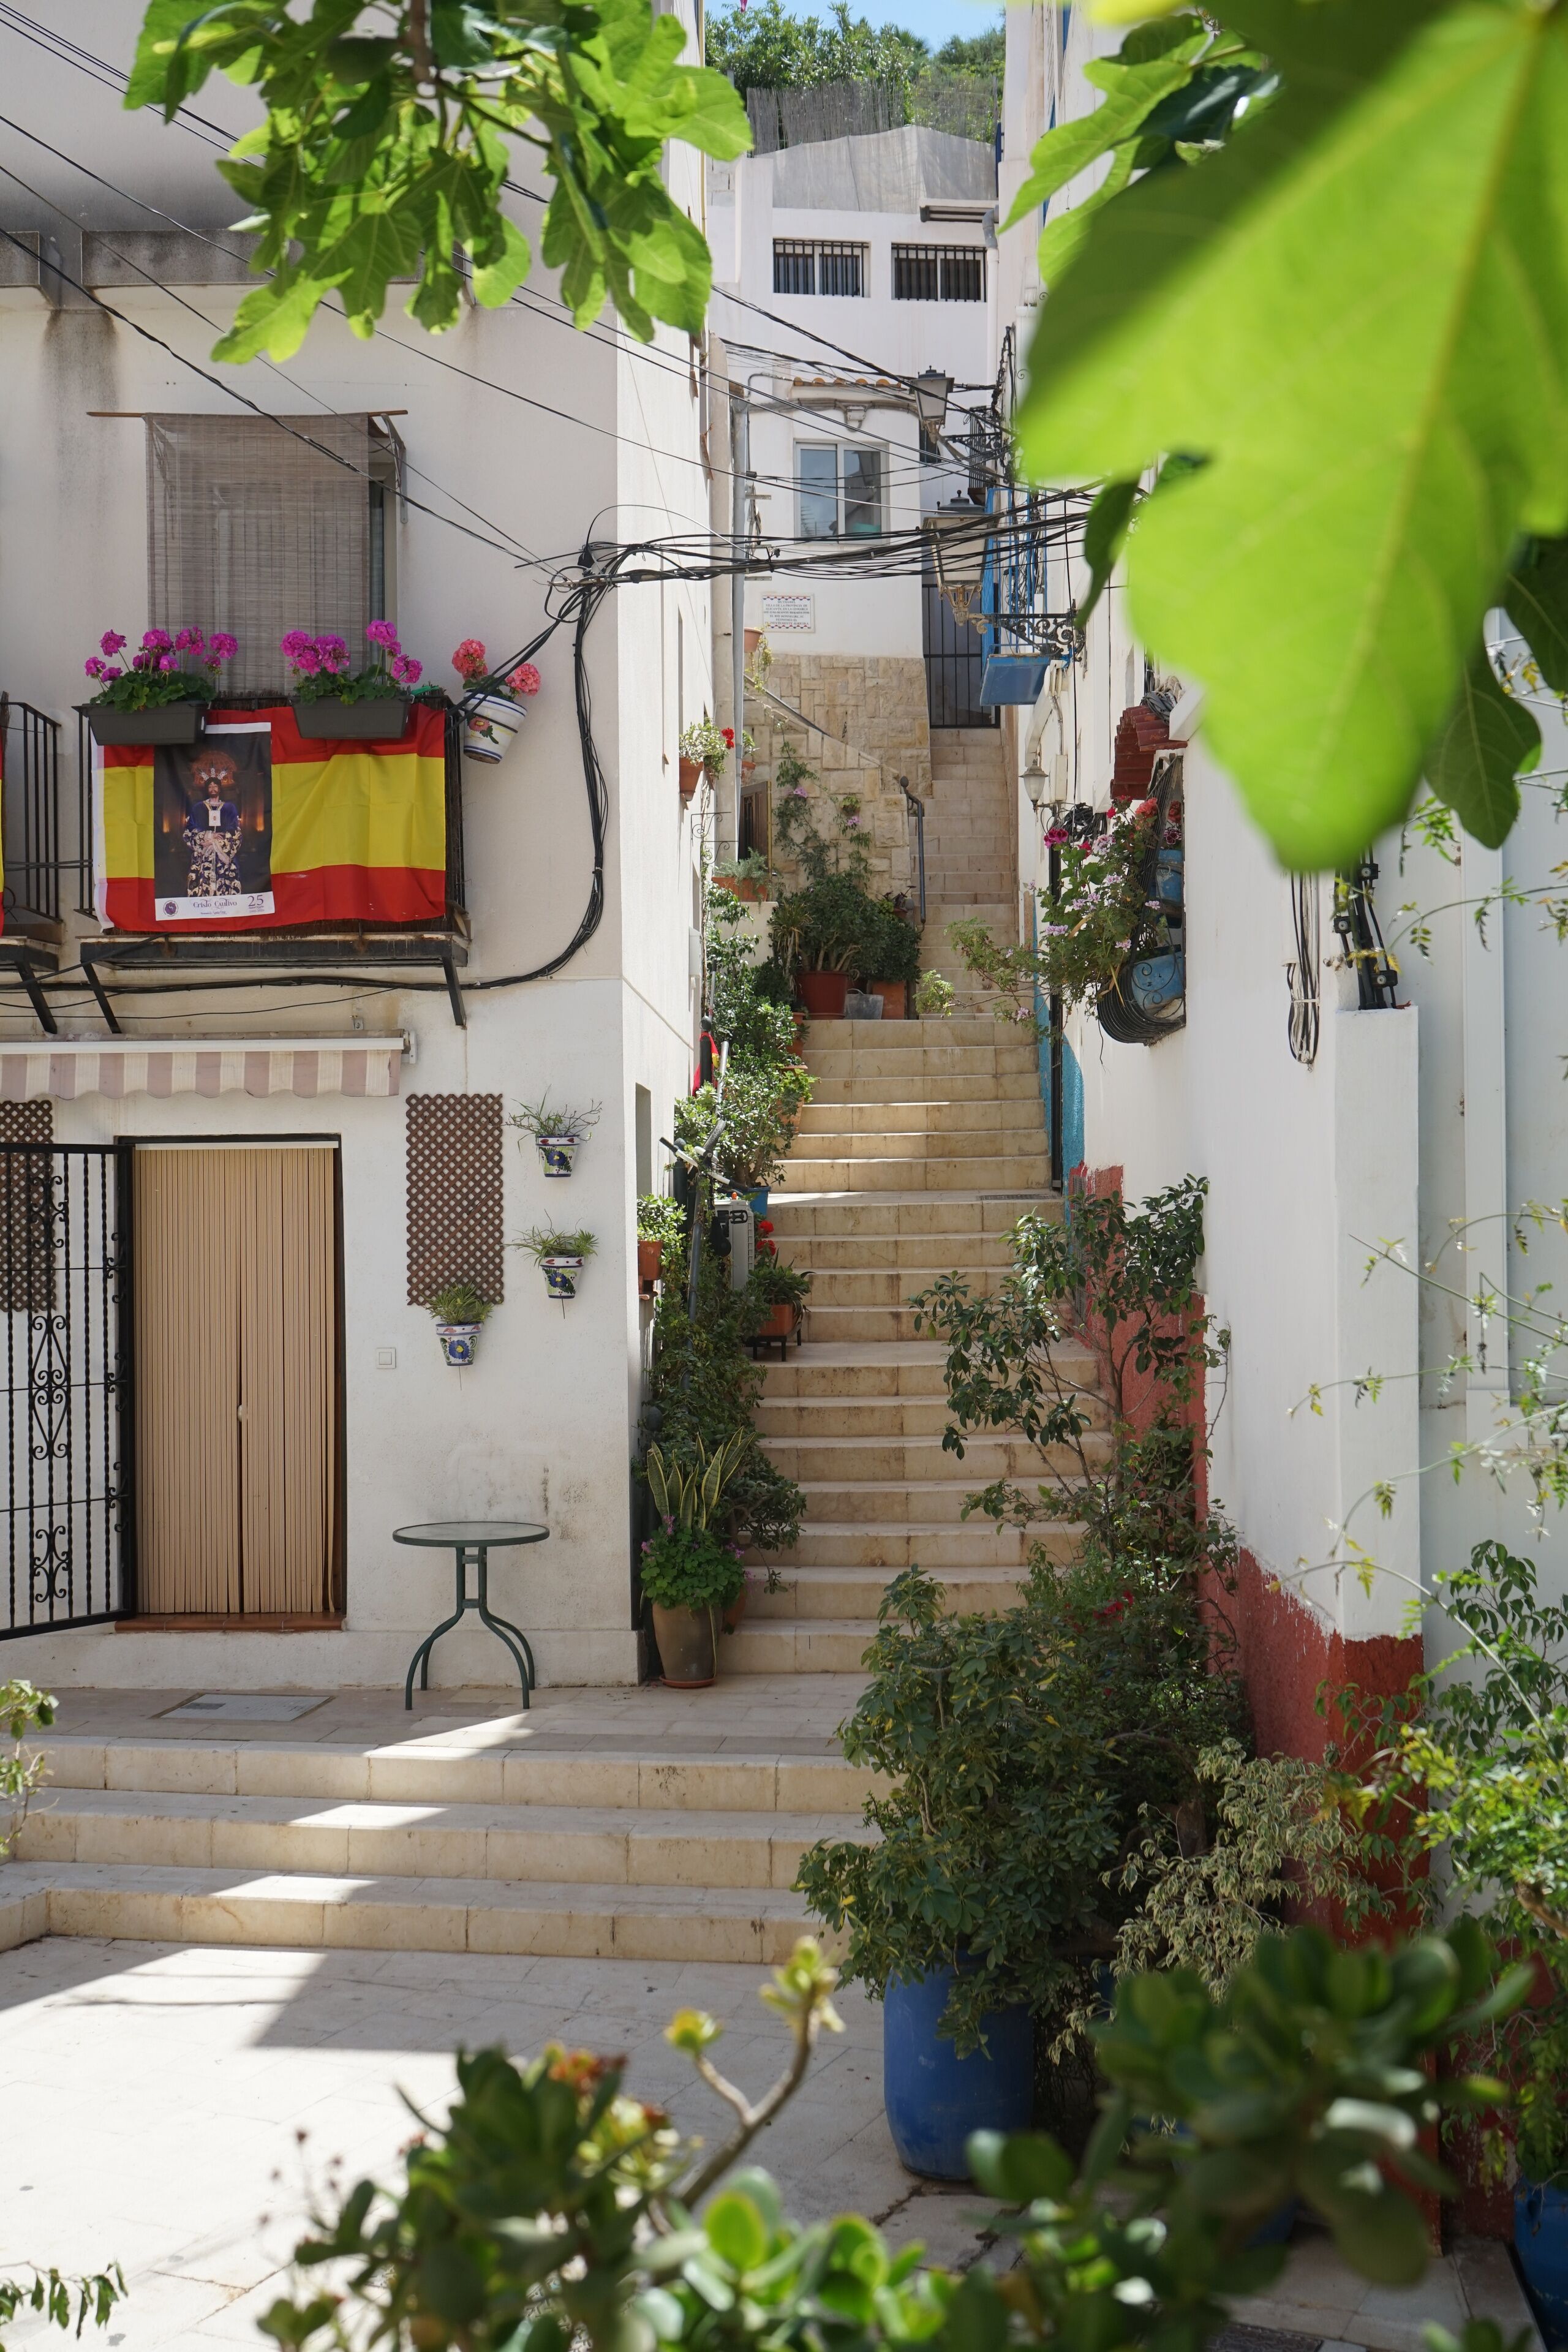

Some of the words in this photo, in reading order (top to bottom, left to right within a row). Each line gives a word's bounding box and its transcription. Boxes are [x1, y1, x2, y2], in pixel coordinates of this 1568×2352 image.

[193, 899, 211, 908] Cristo
[214, 898, 237, 909] Cautivo
[247, 895, 263, 907] 25
